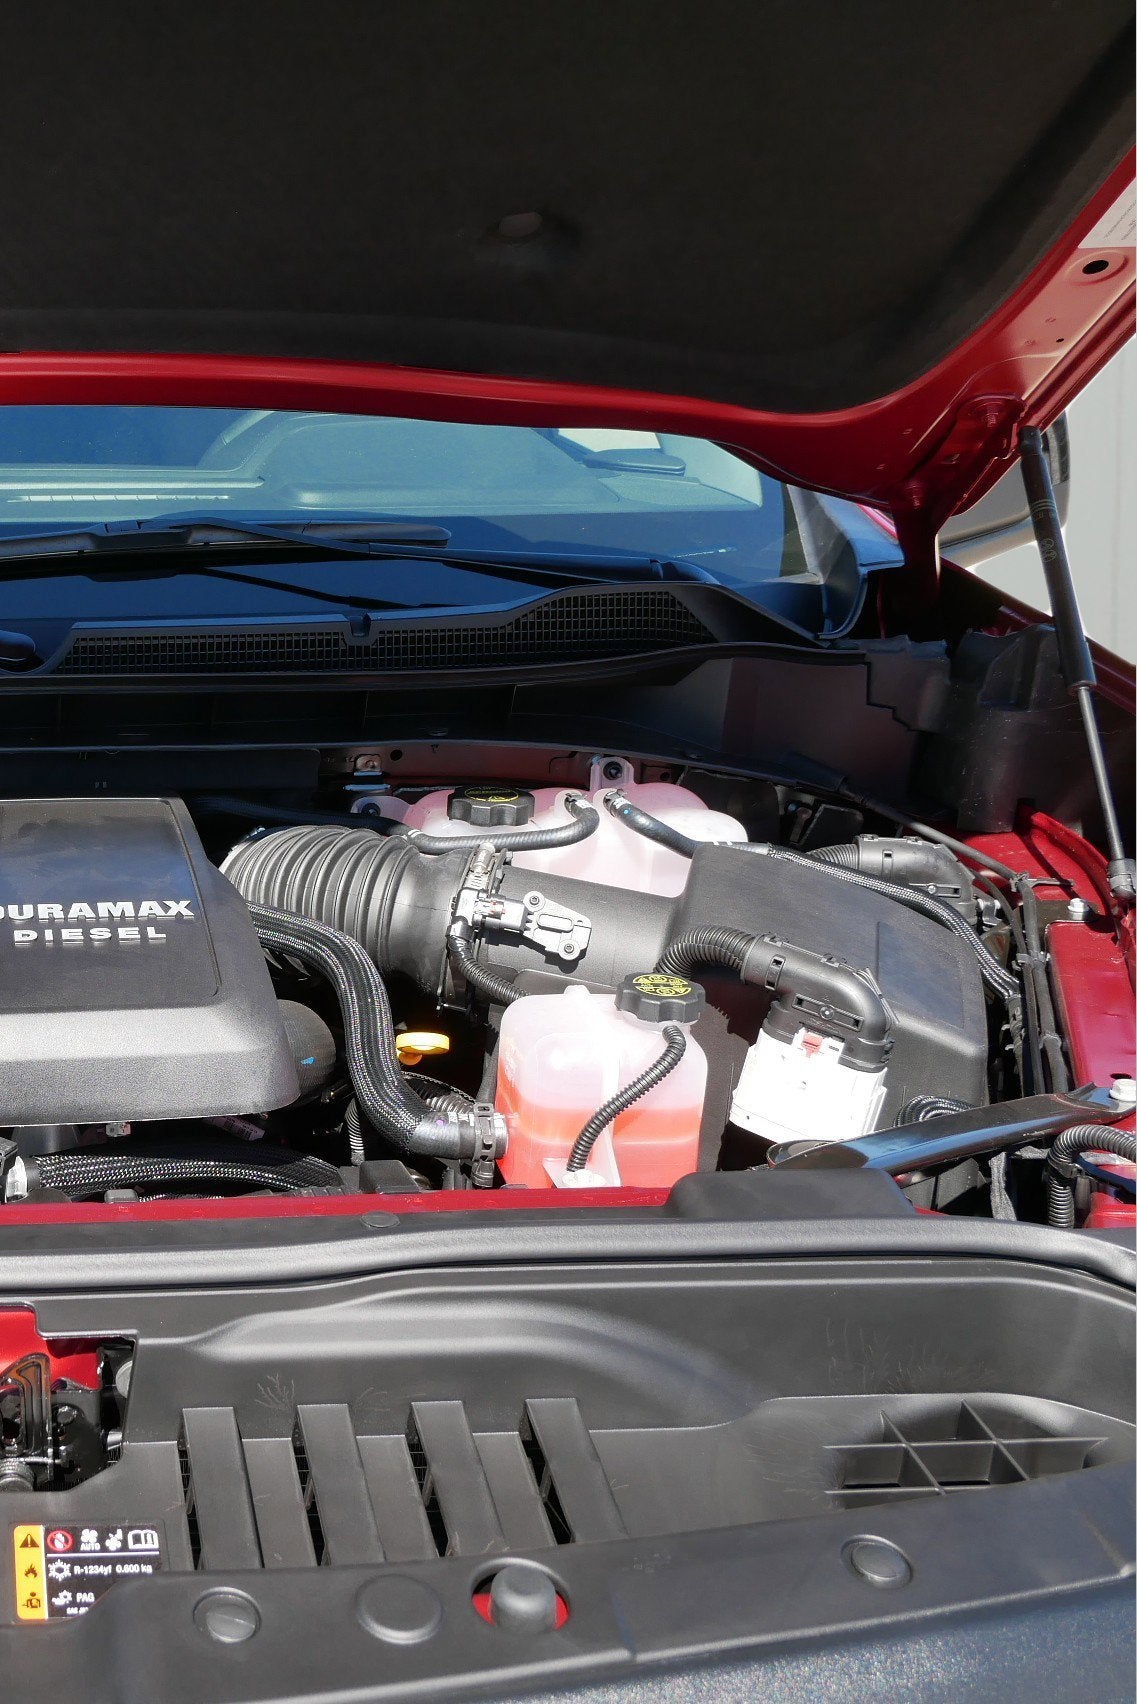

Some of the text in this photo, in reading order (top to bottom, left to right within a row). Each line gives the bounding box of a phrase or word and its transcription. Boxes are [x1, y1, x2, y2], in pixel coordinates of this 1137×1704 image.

[13, 926, 167, 945] DIESEL
[80, 1542, 101, 1551] AUTO
[73, 1564, 112, 1576] R-1234yf
[141, 1563, 153, 1574] kg
[76, 1592, 95, 1603] PAG
